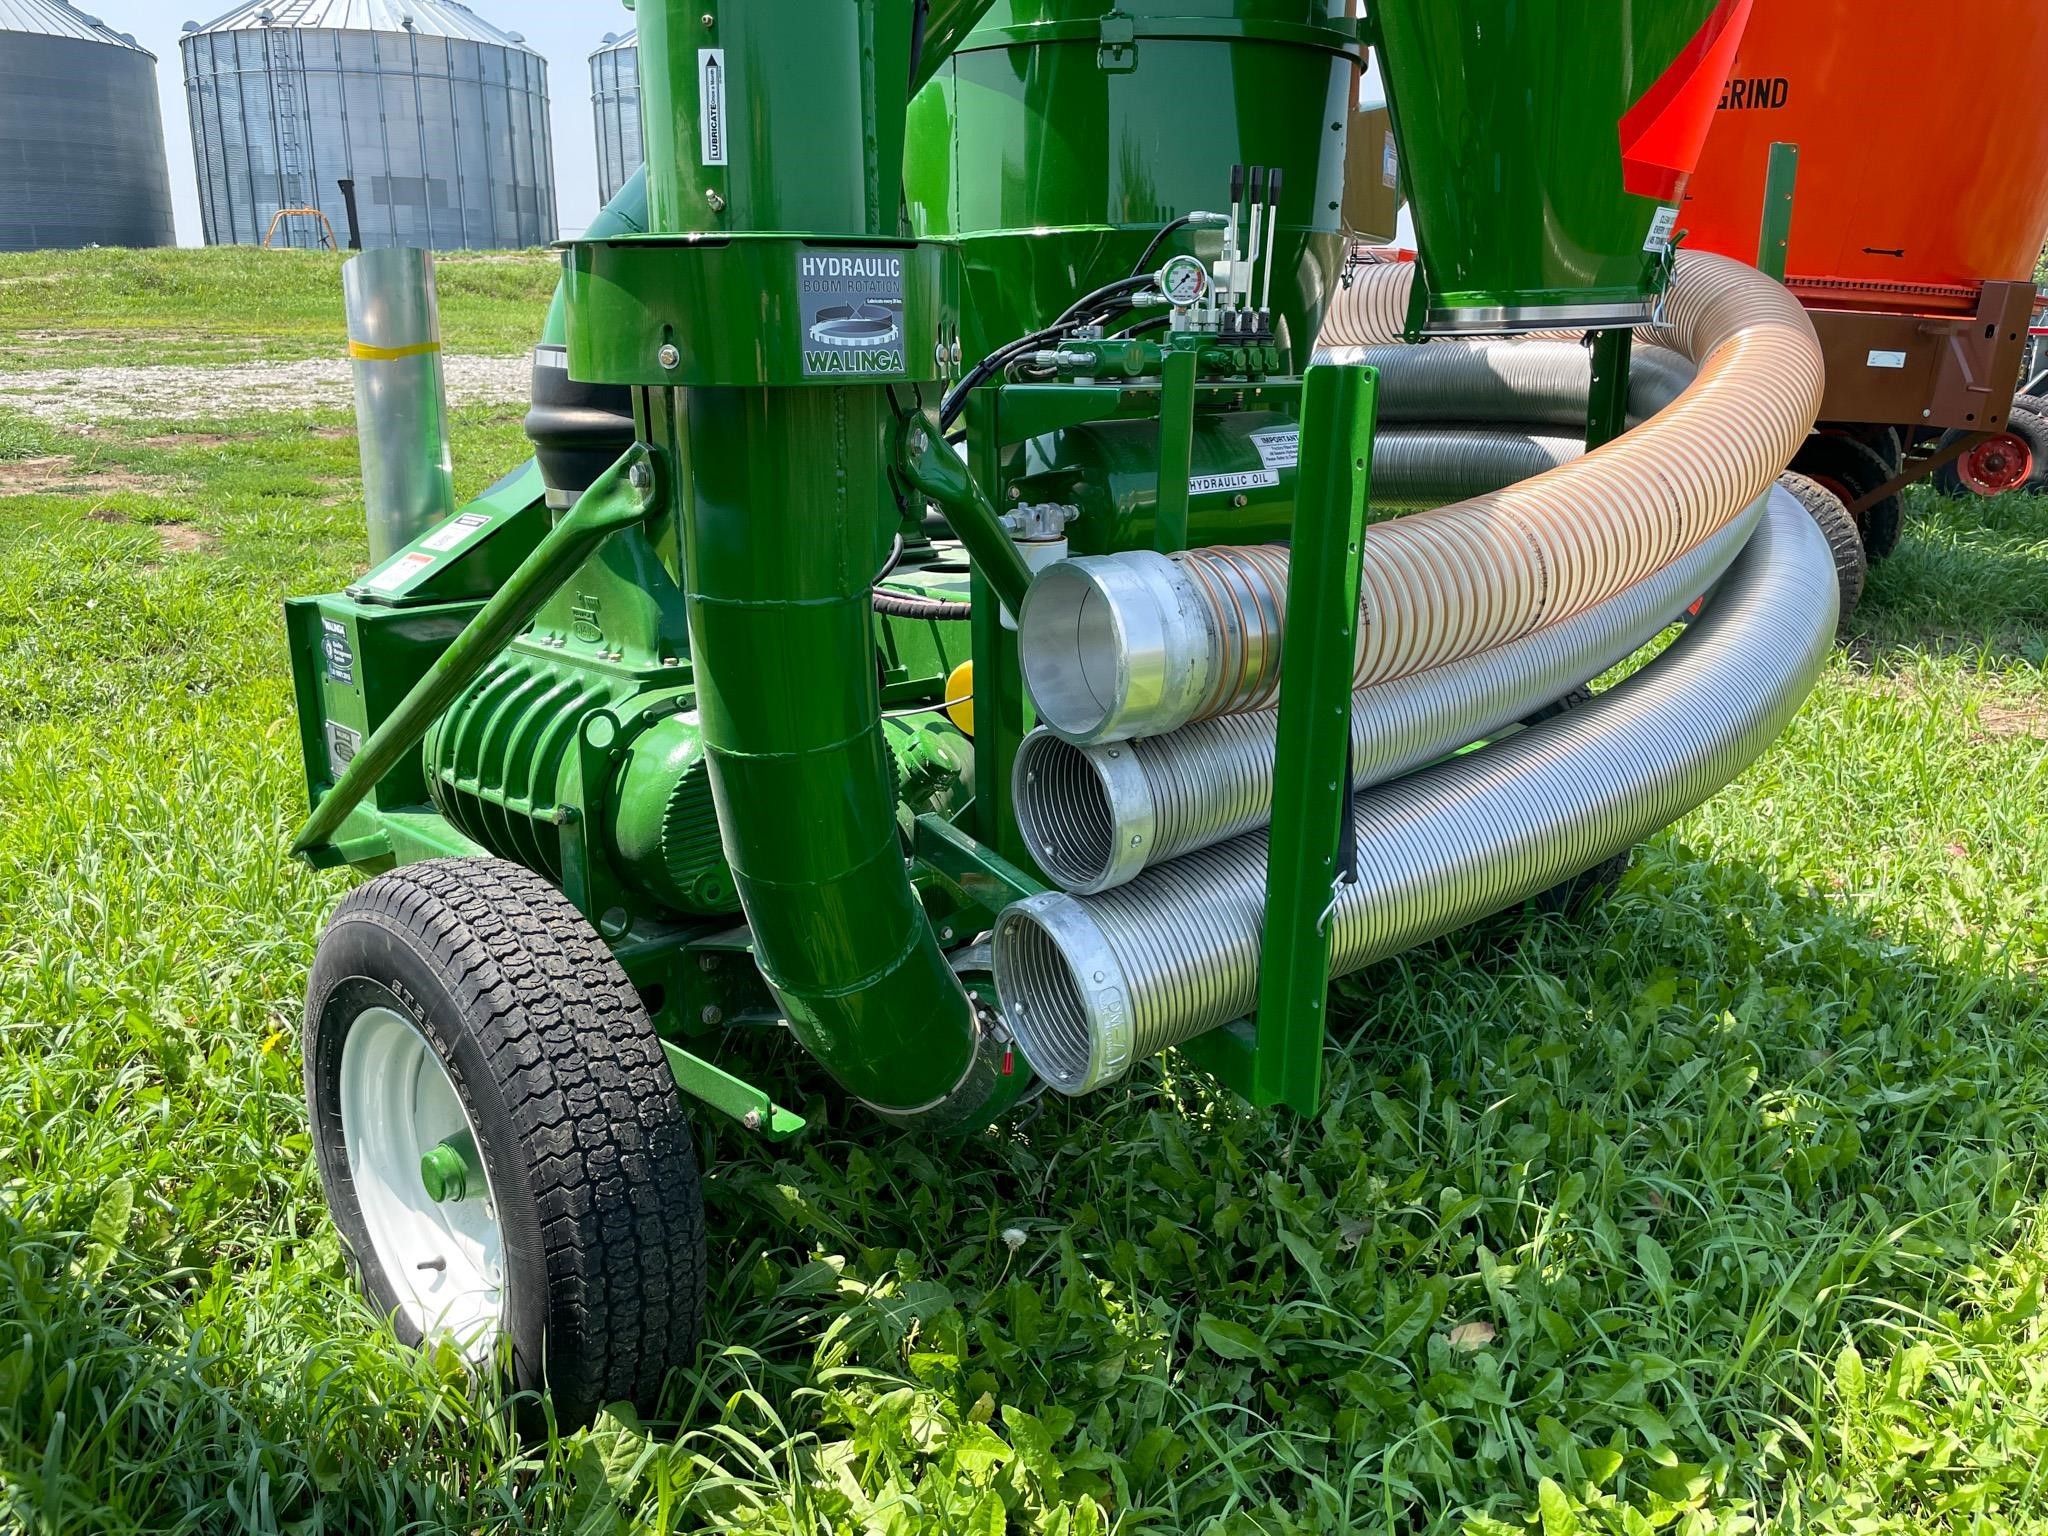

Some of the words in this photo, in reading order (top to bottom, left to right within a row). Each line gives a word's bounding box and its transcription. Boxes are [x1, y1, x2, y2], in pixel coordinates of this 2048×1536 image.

[1716, 78, 1788, 109] GRIND
[710, 104, 718, 157] LUBRICATE
[802, 257, 900, 277] HYDRAULIC
[803, 280, 841, 293] BOOM
[847, 280, 900, 293] ROTATION
[804, 349, 904, 373] WALINGA
[1261, 434, 1299, 444] IMPORTANT
[1189, 476, 1247, 491] HYDRAULIC
[1252, 473, 1268, 485] OIL
